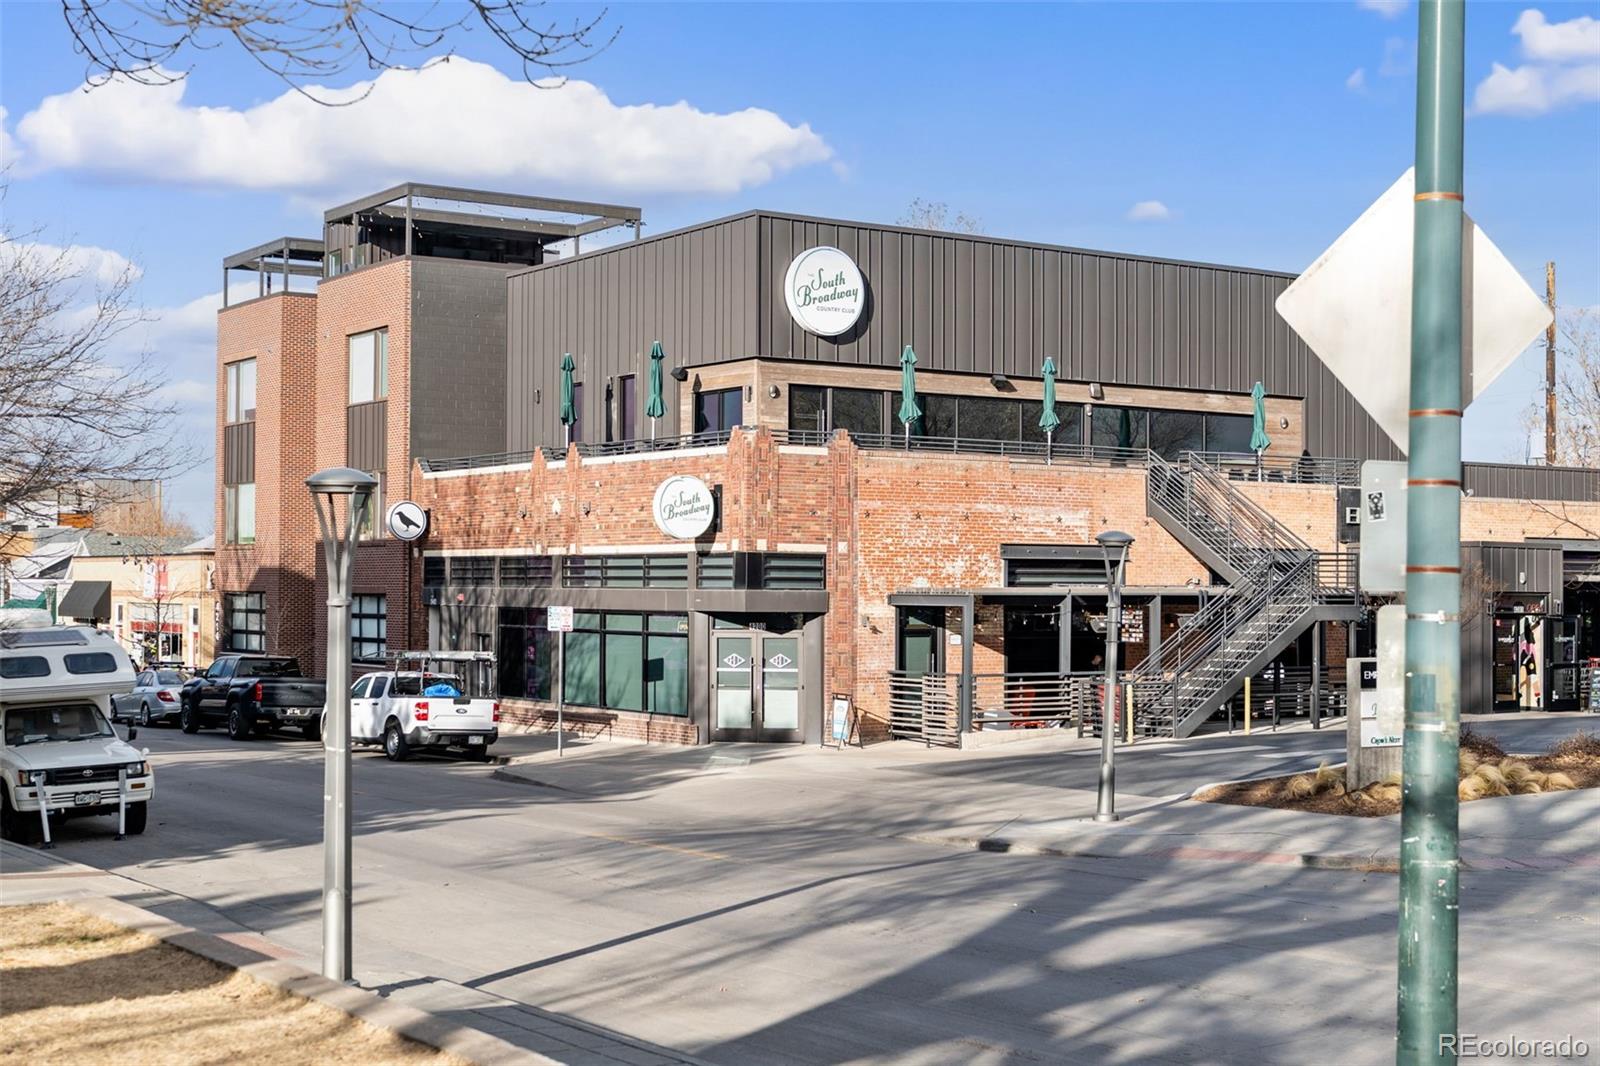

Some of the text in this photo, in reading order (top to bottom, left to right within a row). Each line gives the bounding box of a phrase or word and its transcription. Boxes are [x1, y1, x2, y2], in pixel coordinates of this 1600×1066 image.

[811, 268, 846, 291] South
[797, 285, 859, 308] Broadway
[674, 491, 701, 508] South
[663, 504, 710, 521] Broadway
